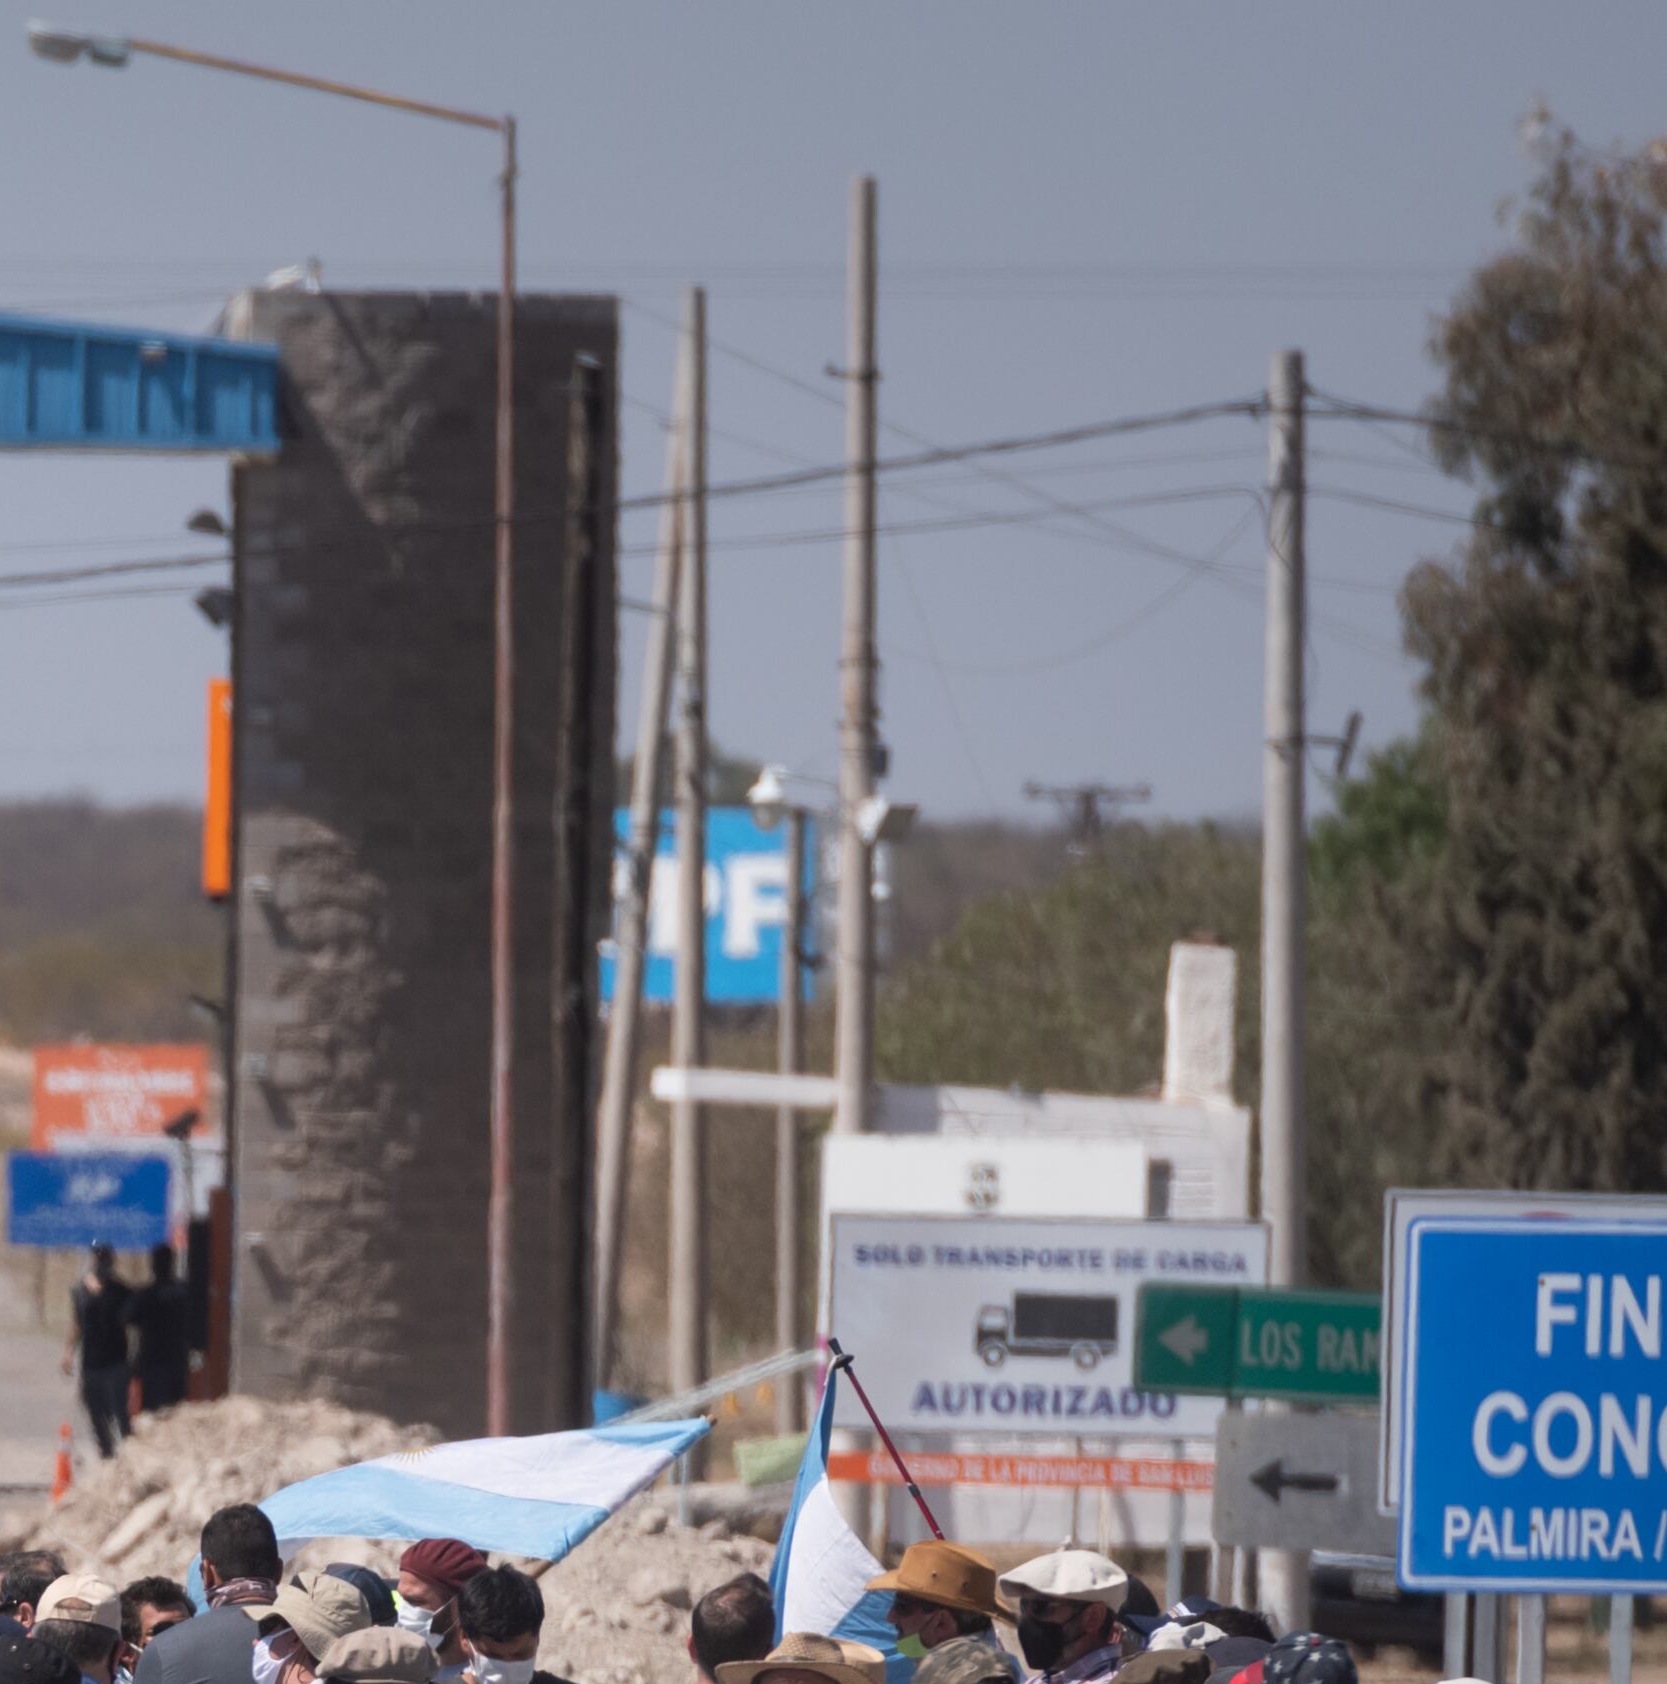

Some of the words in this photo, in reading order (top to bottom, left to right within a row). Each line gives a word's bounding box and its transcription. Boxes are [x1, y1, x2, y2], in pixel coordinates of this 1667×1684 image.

[612, 853, 791, 956] PF
[853, 1244, 925, 1267] SOLO
[933, 1244, 1101, 1270] TRANSPORTE
[1113, 1248, 1147, 1271] DE
[1157, 1249, 1249, 1274] CARGA
[1240, 1318, 1303, 1370] LOS
[1535, 1272, 1661, 1360] FIN
[912, 1381, 1178, 1419] AUTORIZADO
[1472, 1390, 1667, 1479] CON
[1442, 1504, 1643, 1562] PALMIRA
